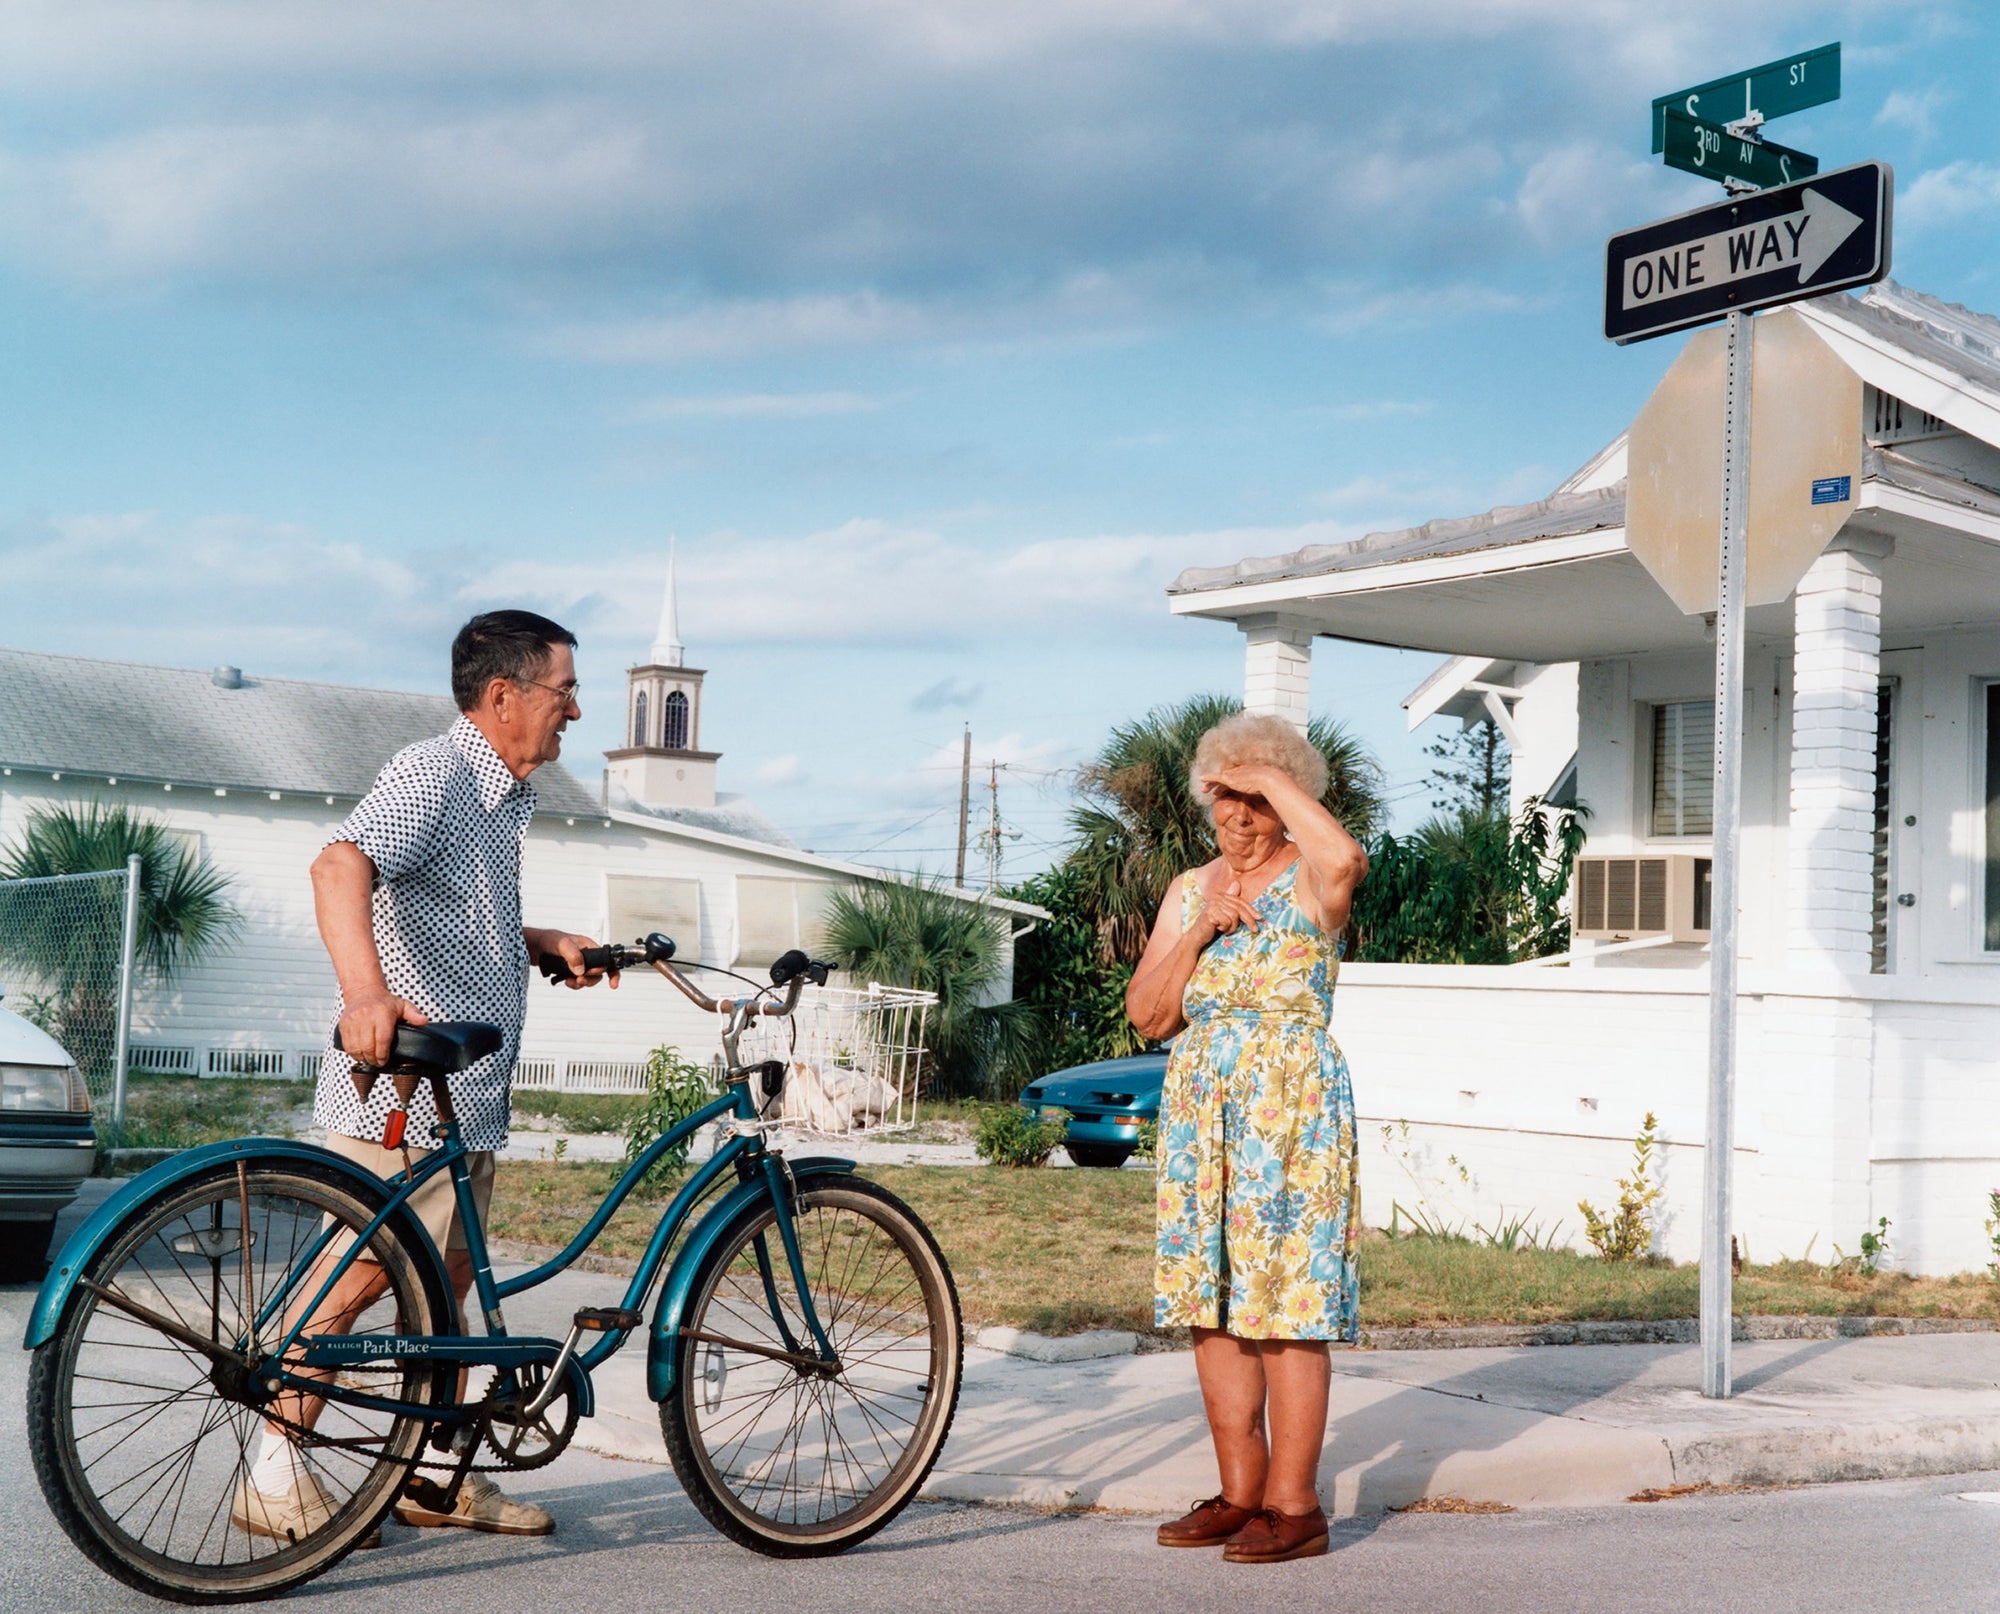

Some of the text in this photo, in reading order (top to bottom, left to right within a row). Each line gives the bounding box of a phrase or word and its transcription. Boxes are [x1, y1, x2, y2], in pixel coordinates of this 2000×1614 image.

[1790, 61, 1807, 86] ST
[1693, 125, 1720, 167] 3RD
[1739, 142, 1754, 164] AV
[1632, 215, 1811, 300] ONE WAY
[362, 1339, 393, 1354] Park
[395, 1340, 429, 1353] Place
